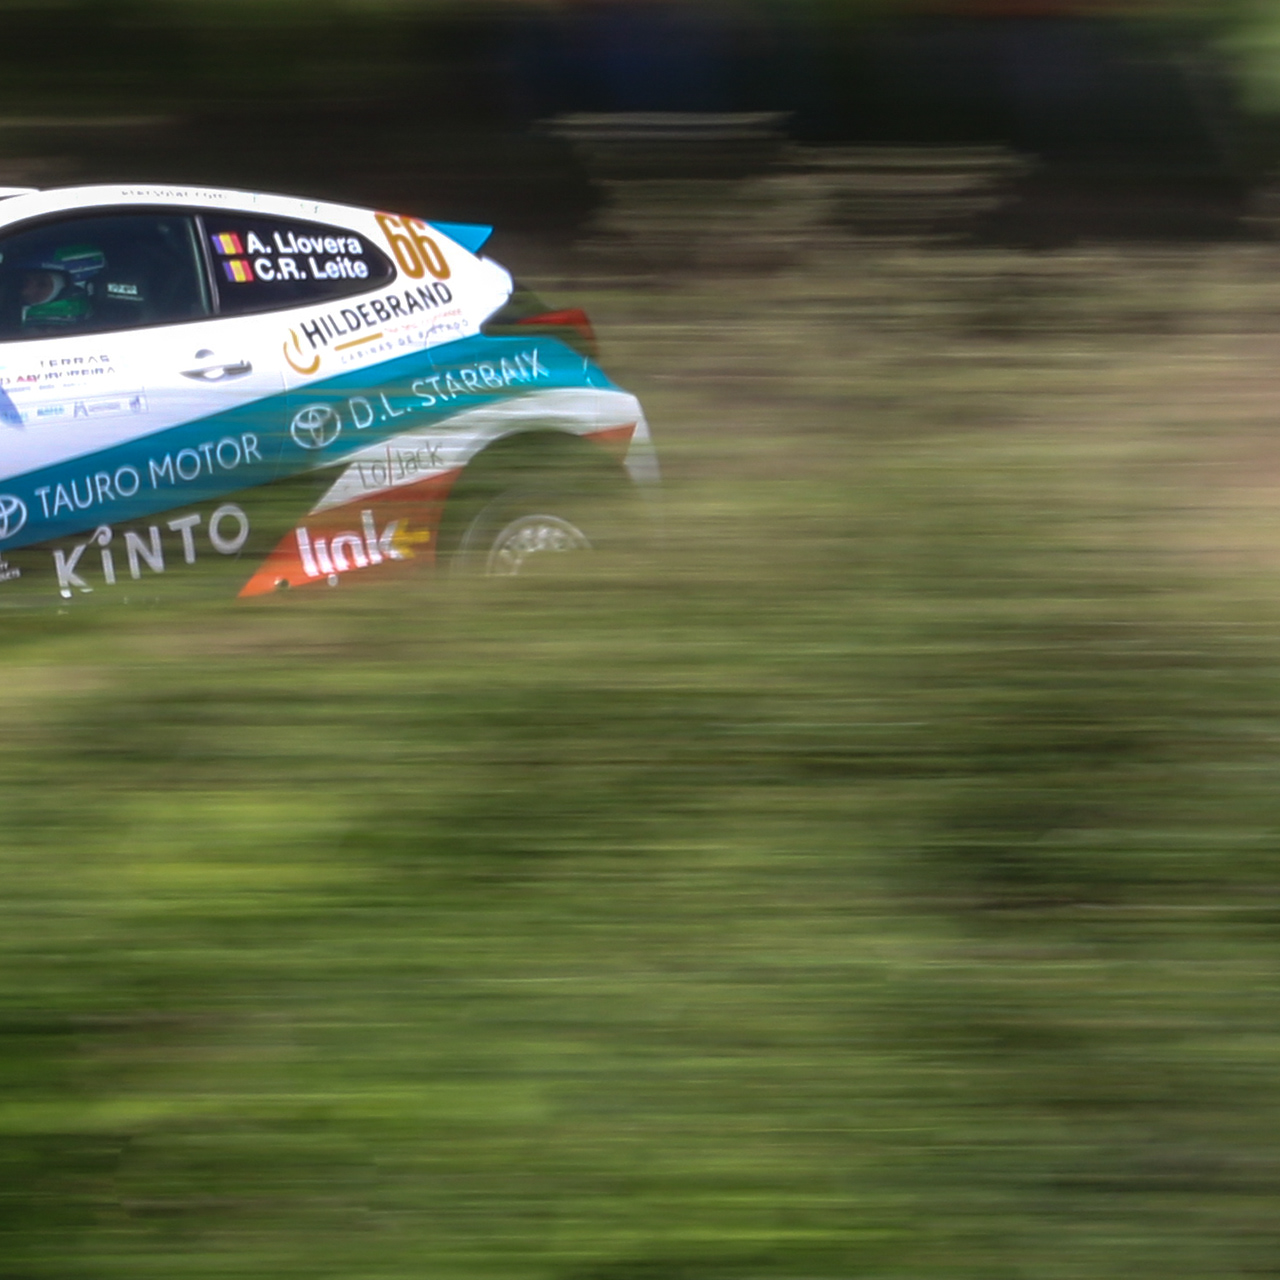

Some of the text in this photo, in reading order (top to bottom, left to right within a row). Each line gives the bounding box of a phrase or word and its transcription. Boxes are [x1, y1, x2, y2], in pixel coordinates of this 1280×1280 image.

[246, 231, 363, 256] A. Llovera
[254, 256, 370, 281] C.R. Leite
[374, 211, 452, 280] 66
[300, 281, 453, 350] HILDEBRAND
[34, 432, 263, 519] TAURO MOTOR
